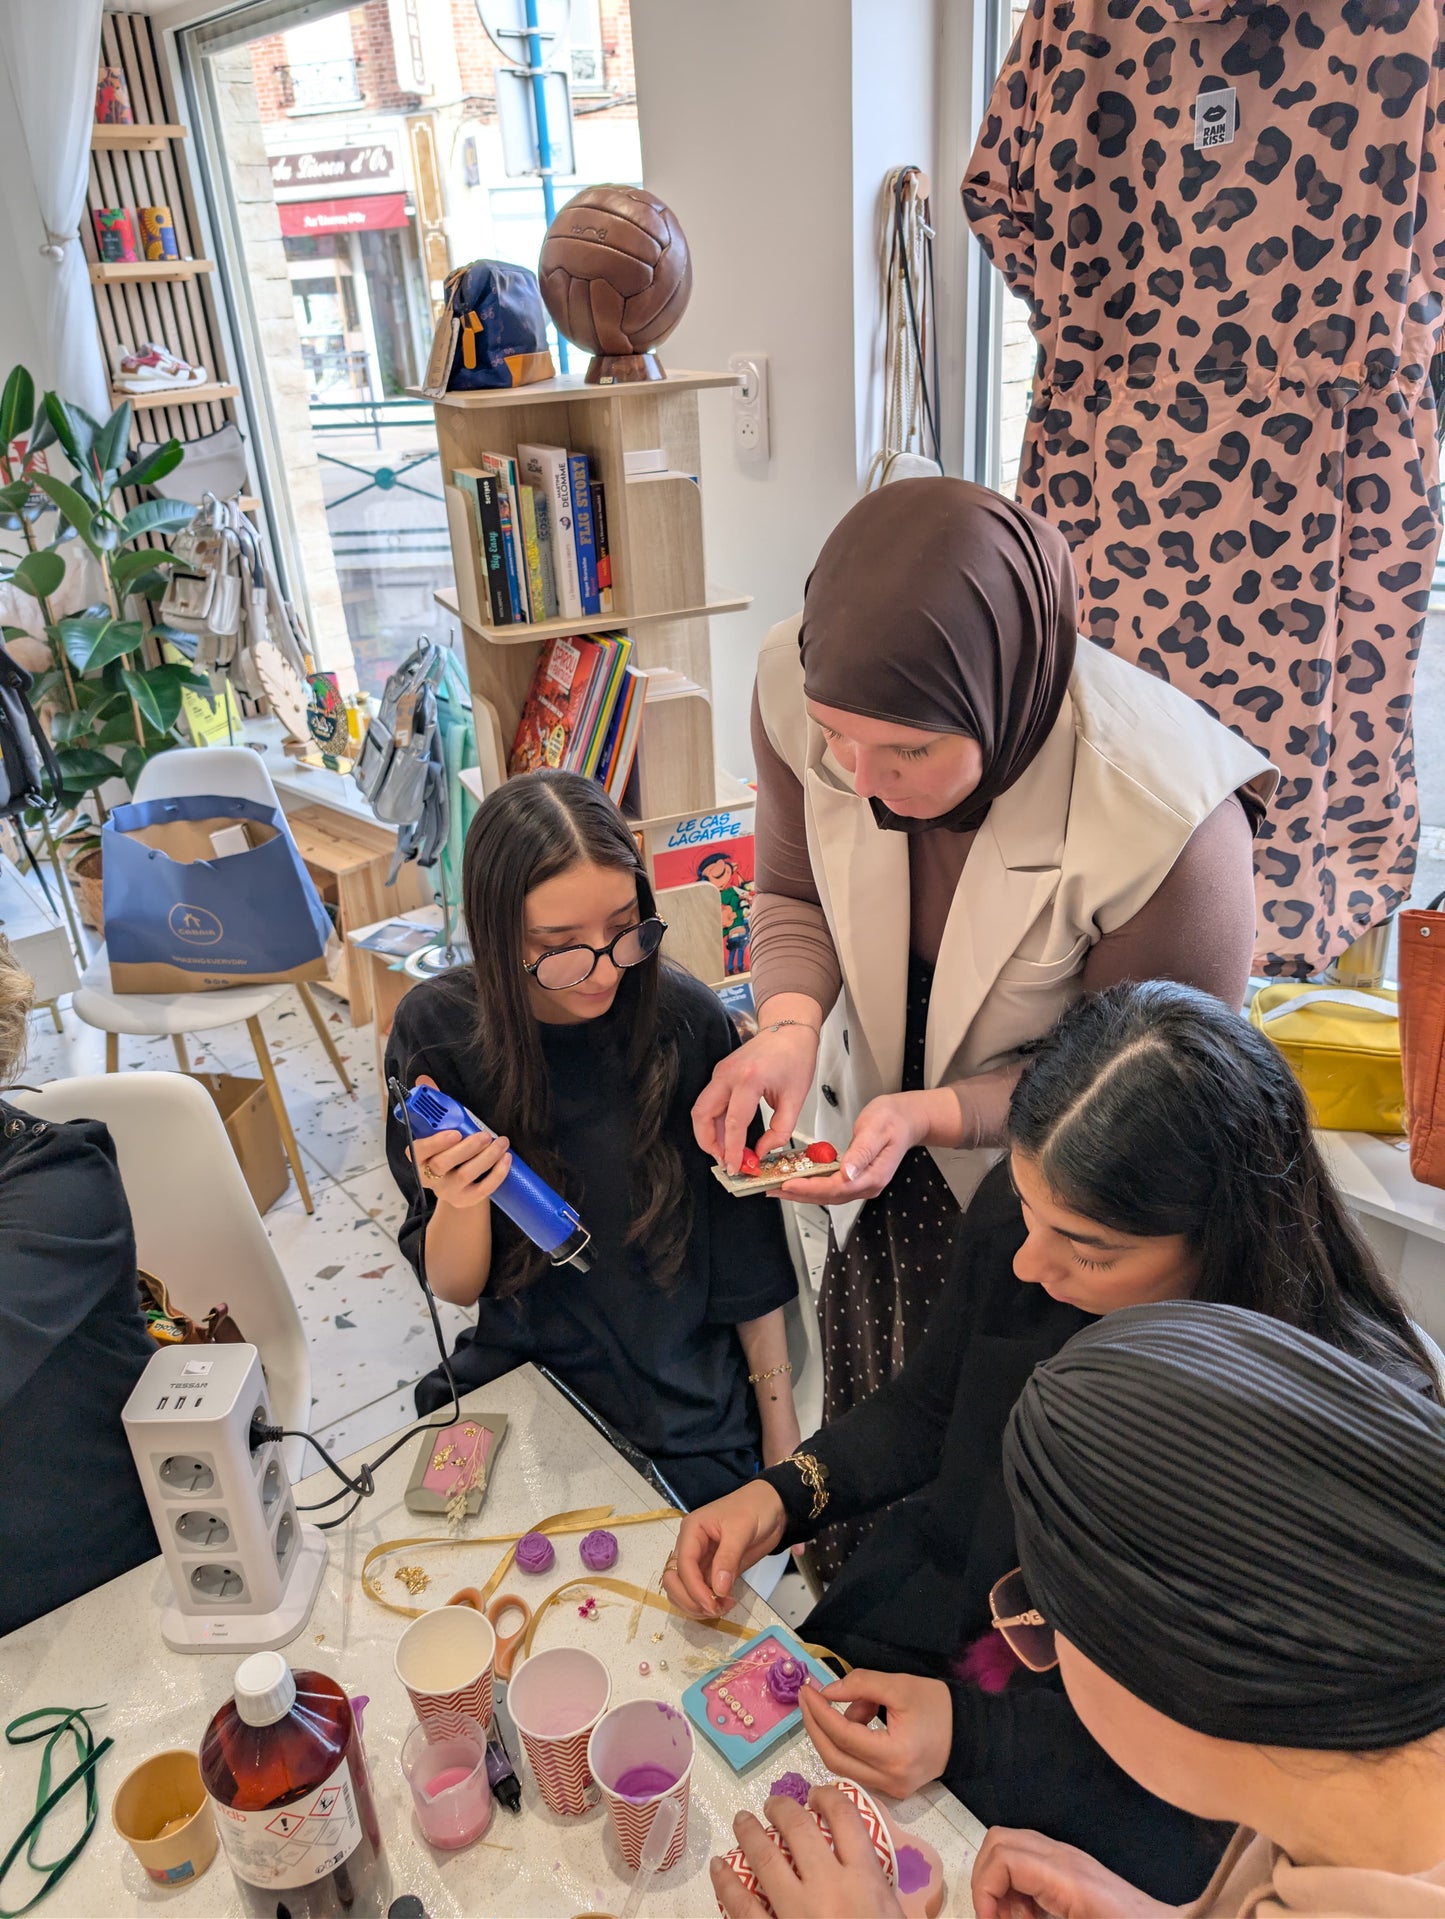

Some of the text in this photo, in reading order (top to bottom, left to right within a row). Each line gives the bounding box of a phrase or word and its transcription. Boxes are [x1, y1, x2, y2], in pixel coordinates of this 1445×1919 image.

[1202, 134, 1225, 146] KISS
[1204, 123, 1226, 136] RAIN
[483, 480, 492, 505] Scripto
[559, 462, 570, 508] DELOMME
[574, 460, 592, 546] FLIC STORY
[488, 531, 502, 570] Big Easy
[668, 822, 740, 848] LAGAFFE
[676, 812, 730, 834] LE CAS
[154, 1323, 182, 1336] Ricola
